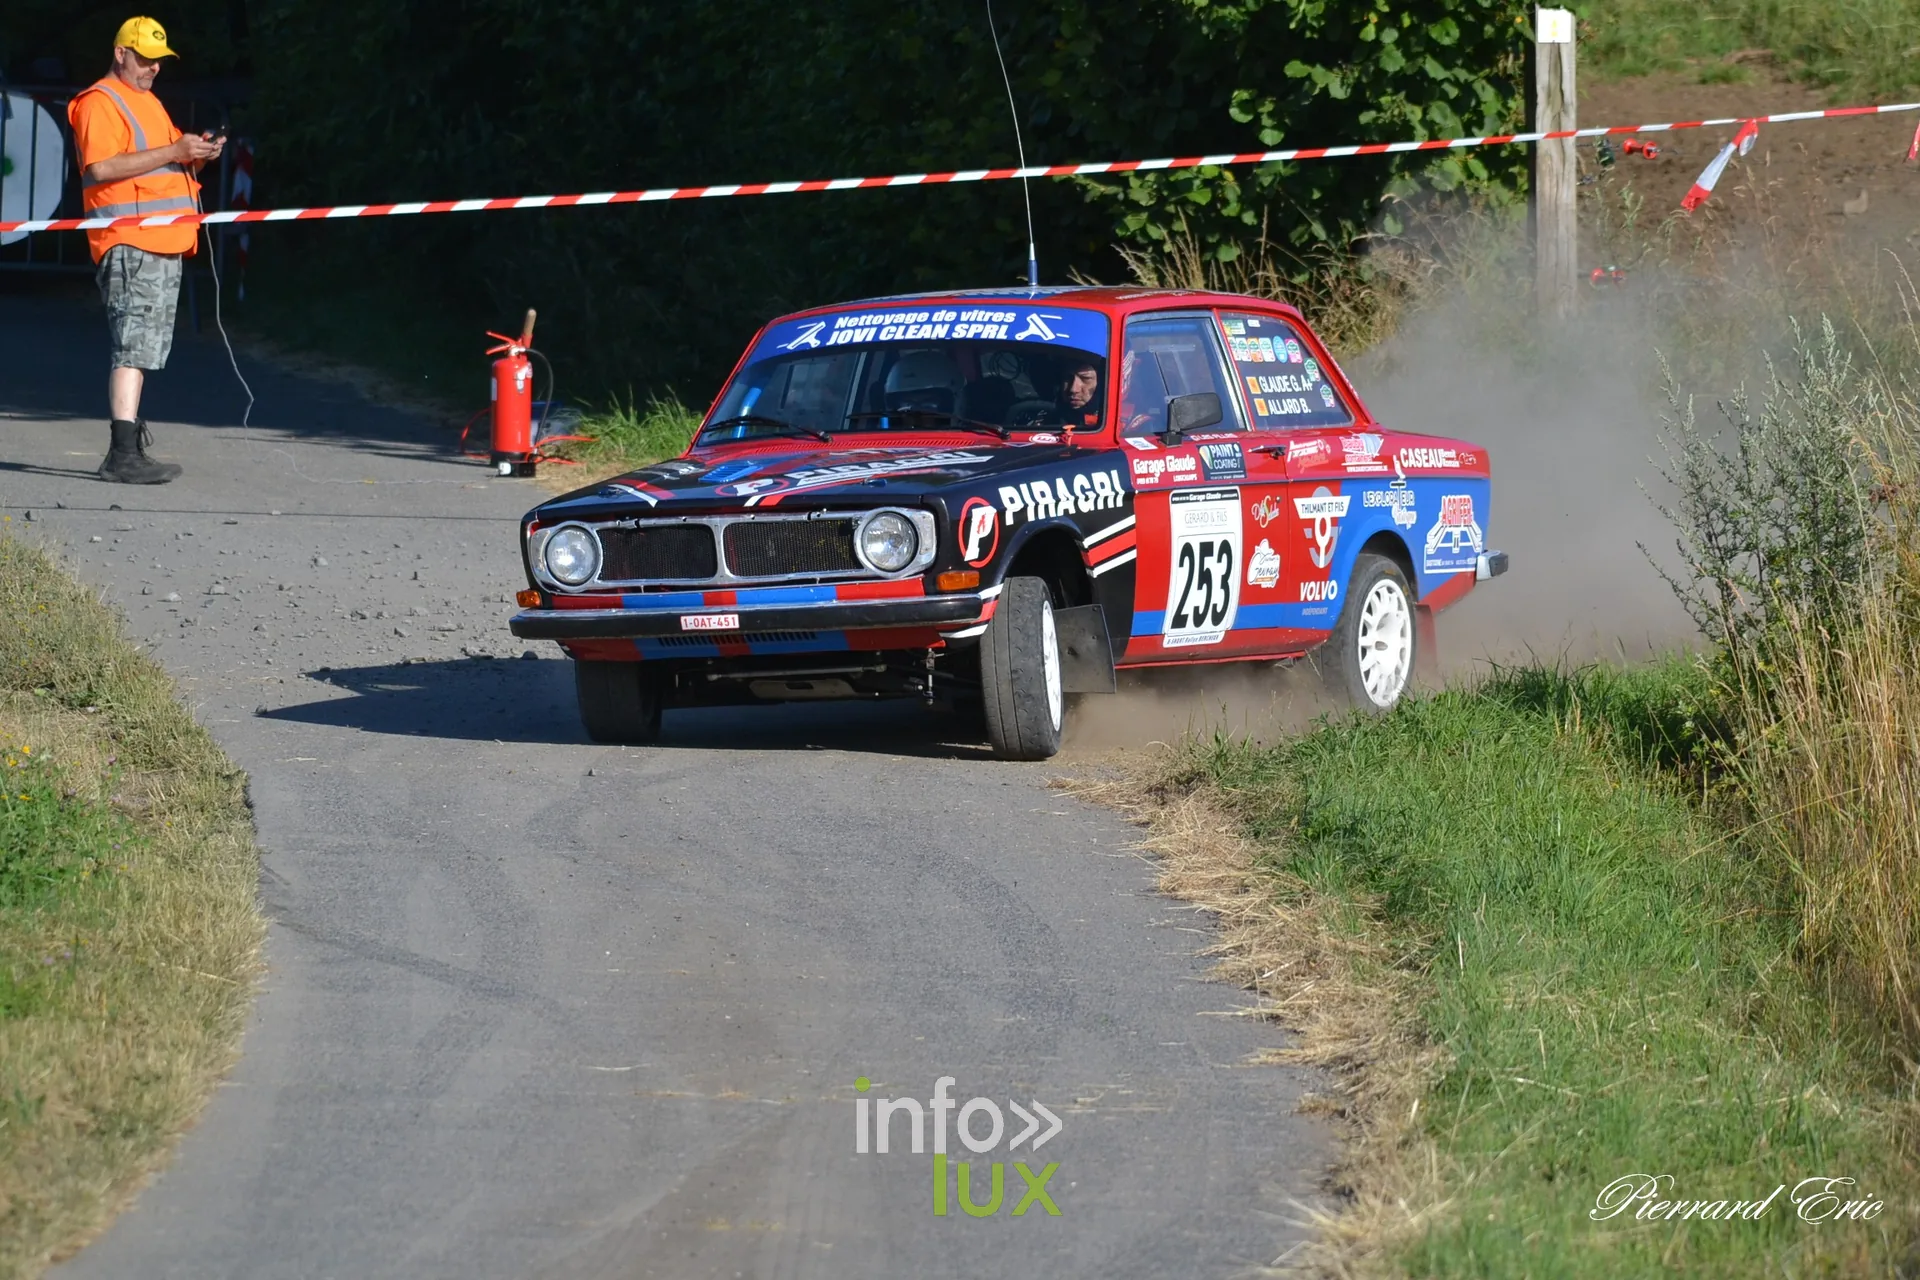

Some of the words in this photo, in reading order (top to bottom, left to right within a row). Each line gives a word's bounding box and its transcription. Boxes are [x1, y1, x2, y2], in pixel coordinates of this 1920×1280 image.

[834, 311, 928, 330] Nettoyage
[931, 310, 957, 323] de
[960, 309, 1016, 324] vitres
[825, 326, 880, 346] JOVI
[880, 324, 949, 342] CLEAN
[951, 323, 1009, 340] SPRL
[1258, 375, 1292, 393] GLAUDE
[1267, 399, 1301, 415] ALLARD
[1300, 397, 1312, 414] B.
[1209, 443, 1234, 458] PAINT
[1400, 447, 1444, 469] CASEAU
[784, 451, 978, 479] PIRAGRI
[1133, 458, 1166, 477] Garage
[1165, 454, 1196, 473] Glaude
[1213, 458, 1237, 470] COATING
[998, 469, 1126, 526] PIRAGRI
[1301, 502, 1327, 514] THILMANT
[1327, 502, 1334, 513] ET
[1334, 501, 1345, 512] FILS
[964, 505, 997, 562] P
[1170, 539, 1233, 630] 253
[1300, 579, 1338, 602] VOLVO
